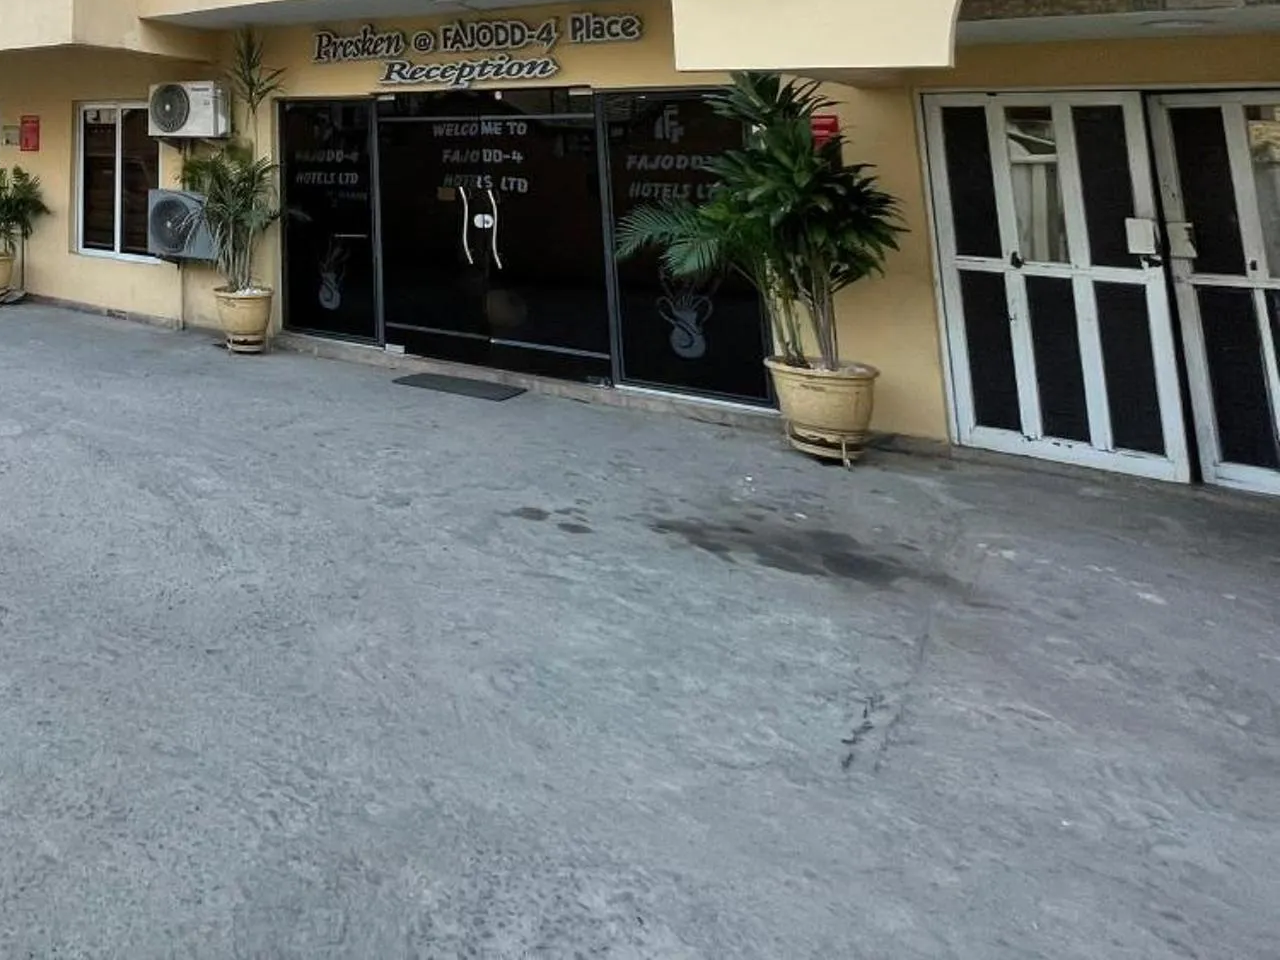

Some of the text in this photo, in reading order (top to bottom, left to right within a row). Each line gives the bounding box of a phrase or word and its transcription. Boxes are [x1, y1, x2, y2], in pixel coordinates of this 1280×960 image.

[314, 11, 641, 62] Presken @ FAJODD-4 Place
[380, 53, 559, 89] Reception
[432, 121, 529, 137] WELCOME TO
[626, 154, 705, 171] FAJODD
[338, 172, 360, 186] LTD
[500, 175, 529, 193] LTD
[628, 181, 692, 200] HOTELS
